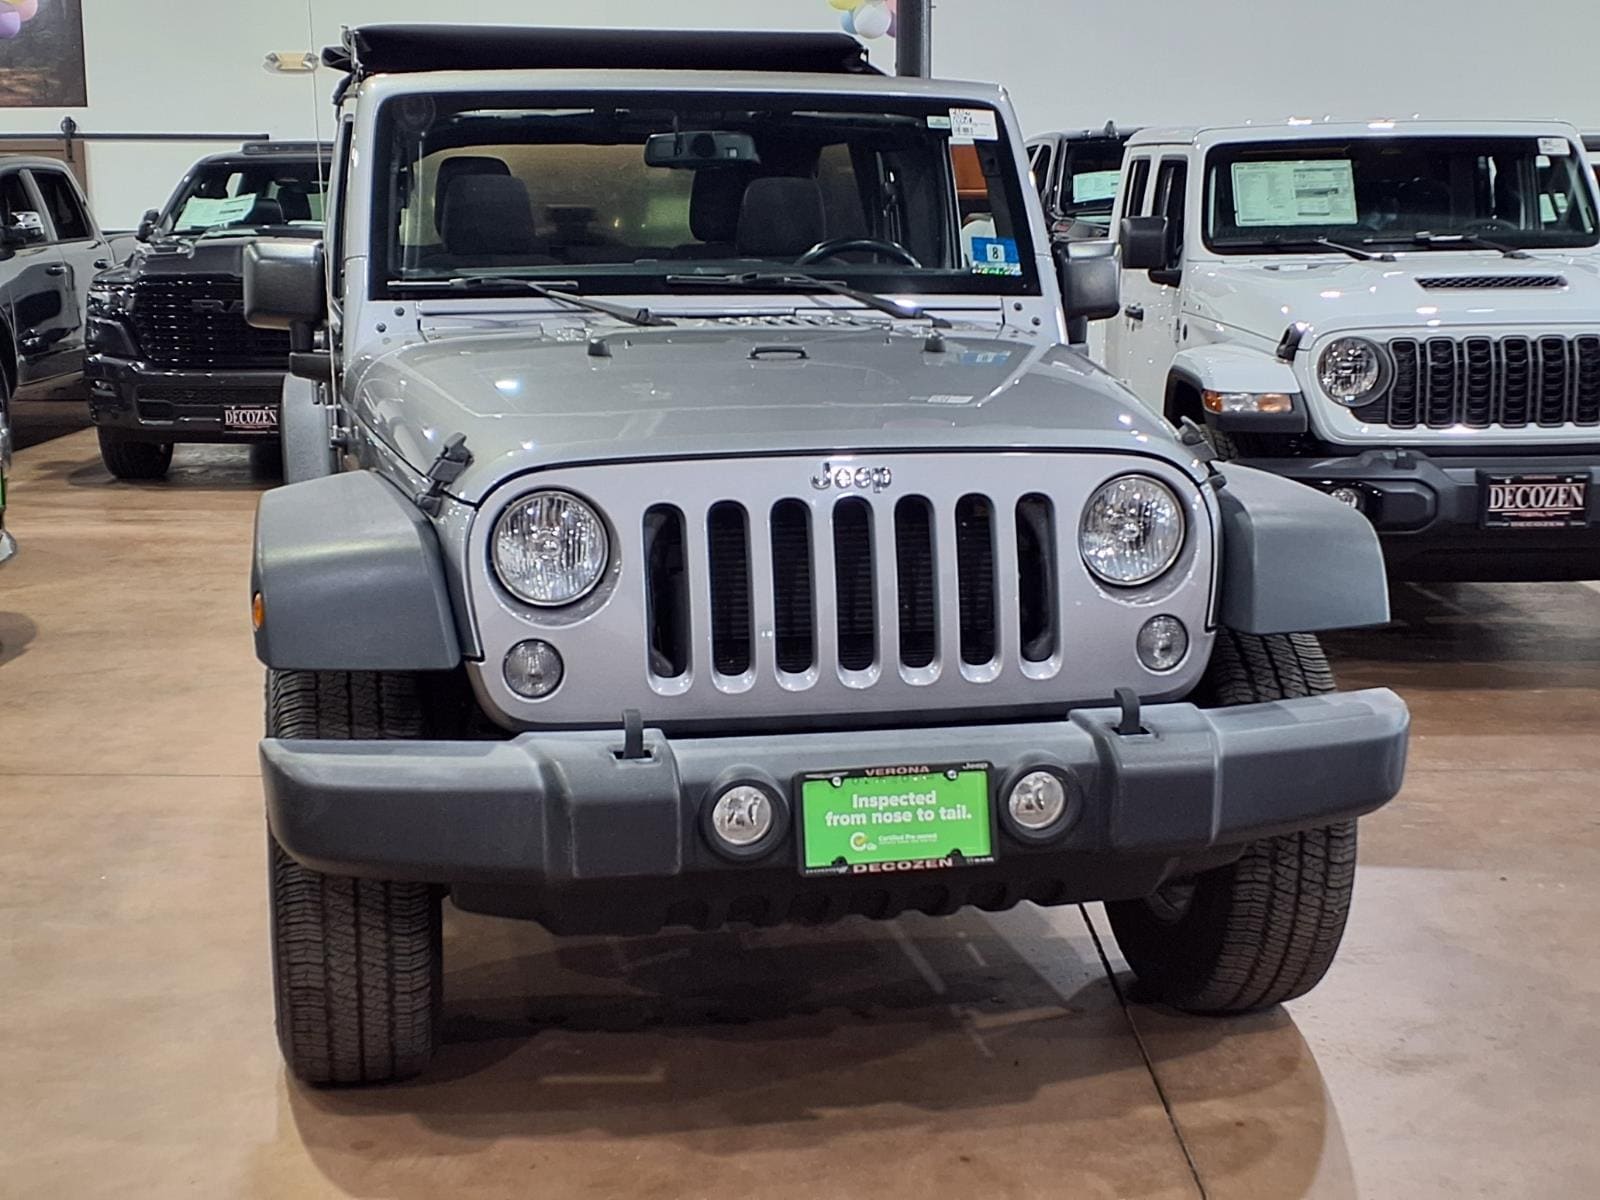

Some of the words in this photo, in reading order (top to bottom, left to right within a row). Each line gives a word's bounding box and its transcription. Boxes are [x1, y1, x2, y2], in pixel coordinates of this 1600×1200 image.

[992, 246, 999, 260] 8
[225, 410, 277, 425] DECOZEN
[811, 462, 892, 493] Jeep
[1489, 485, 1585, 509] DECOZEN
[865, 765, 930, 776] VERONA
[852, 790, 937, 811] Inspected
[825, 811, 867, 827] from
[871, 810, 913, 824] nose
[916, 808, 935, 822] to
[939, 804, 972, 820] tail.
[853, 858, 953, 873] DECOZEN
